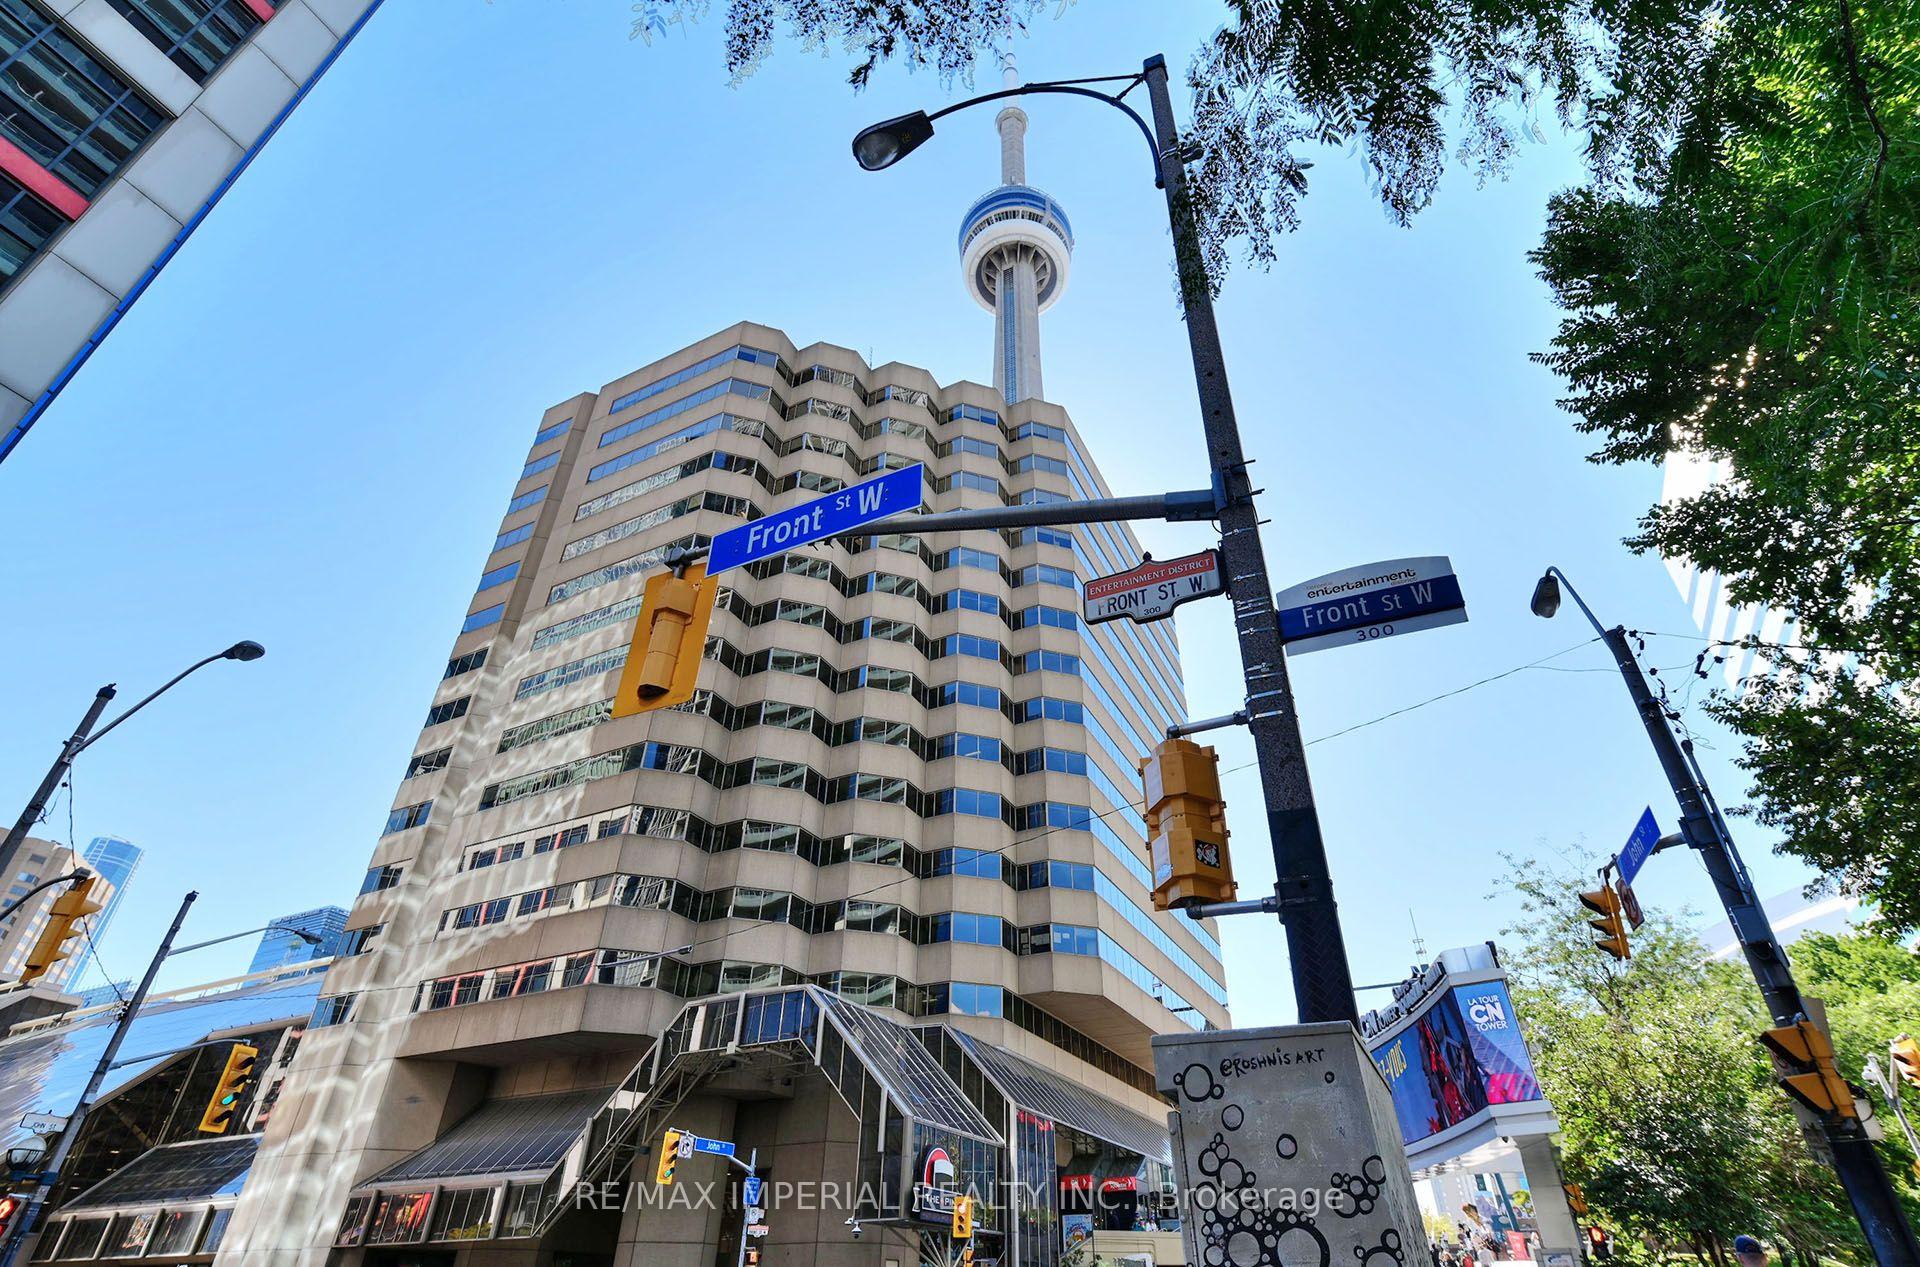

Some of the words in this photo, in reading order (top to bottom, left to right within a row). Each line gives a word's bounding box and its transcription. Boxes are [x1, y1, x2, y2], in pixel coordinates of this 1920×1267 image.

[746, 505, 824, 554] Front
[835, 496, 850, 510] St
[858, 481, 884, 516] W
[1089, 570, 1166, 596] ENTERTAINMENT
[1168, 558, 1211, 576] DISTRICT
[1307, 568, 1417, 599] entertainment
[1098, 588, 1148, 616] FRONT
[1158, 581, 1180, 601] ST.
[1188, 575, 1206, 593] W.
[1302, 597, 1370, 628] Front
[1381, 593, 1403, 613] St
[1410, 581, 1433, 605] W
[1143, 605, 1161, 616] 300
[1356, 624, 1395, 641] 300
[1466, 998, 1478, 1006] LA
[1478, 994, 1500, 1004] TOUR
[1469, 1001, 1505, 1024] CN
[1475, 1020, 1508, 1032] TOWER
[1295, 1047, 1326, 1065] ART
[706, 1141, 721, 1151] John
[925, 1193, 940, 1205] THE
